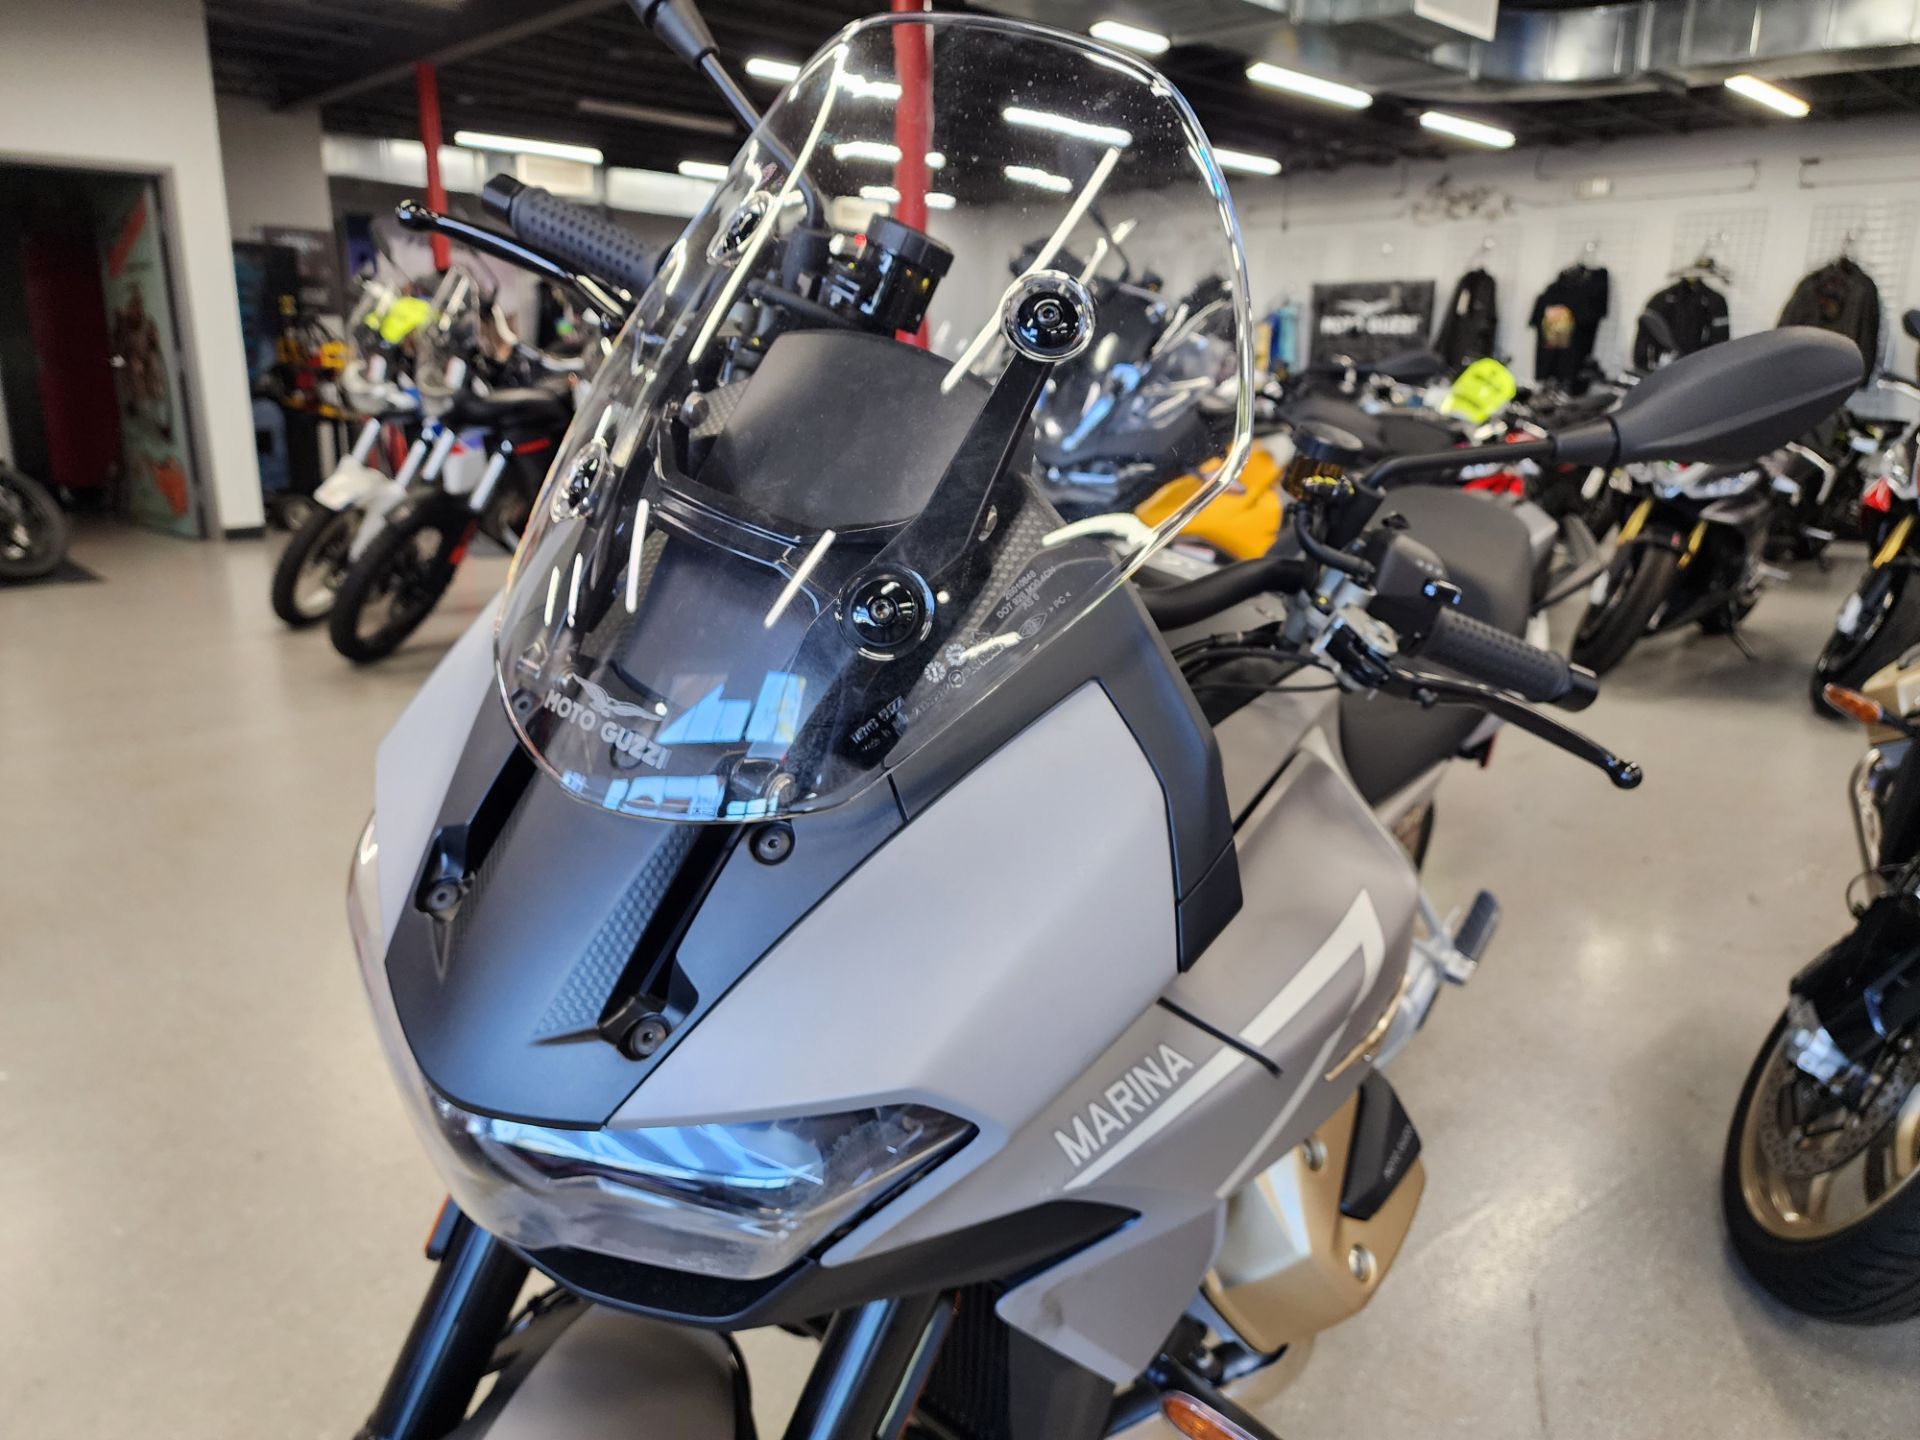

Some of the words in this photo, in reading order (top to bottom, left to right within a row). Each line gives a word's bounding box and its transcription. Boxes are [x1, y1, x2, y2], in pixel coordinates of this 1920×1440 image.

[543, 689, 597, 732] MOTO
[600, 721, 673, 770] GUZZI
[1053, 1043, 1195, 1168] MARINA
